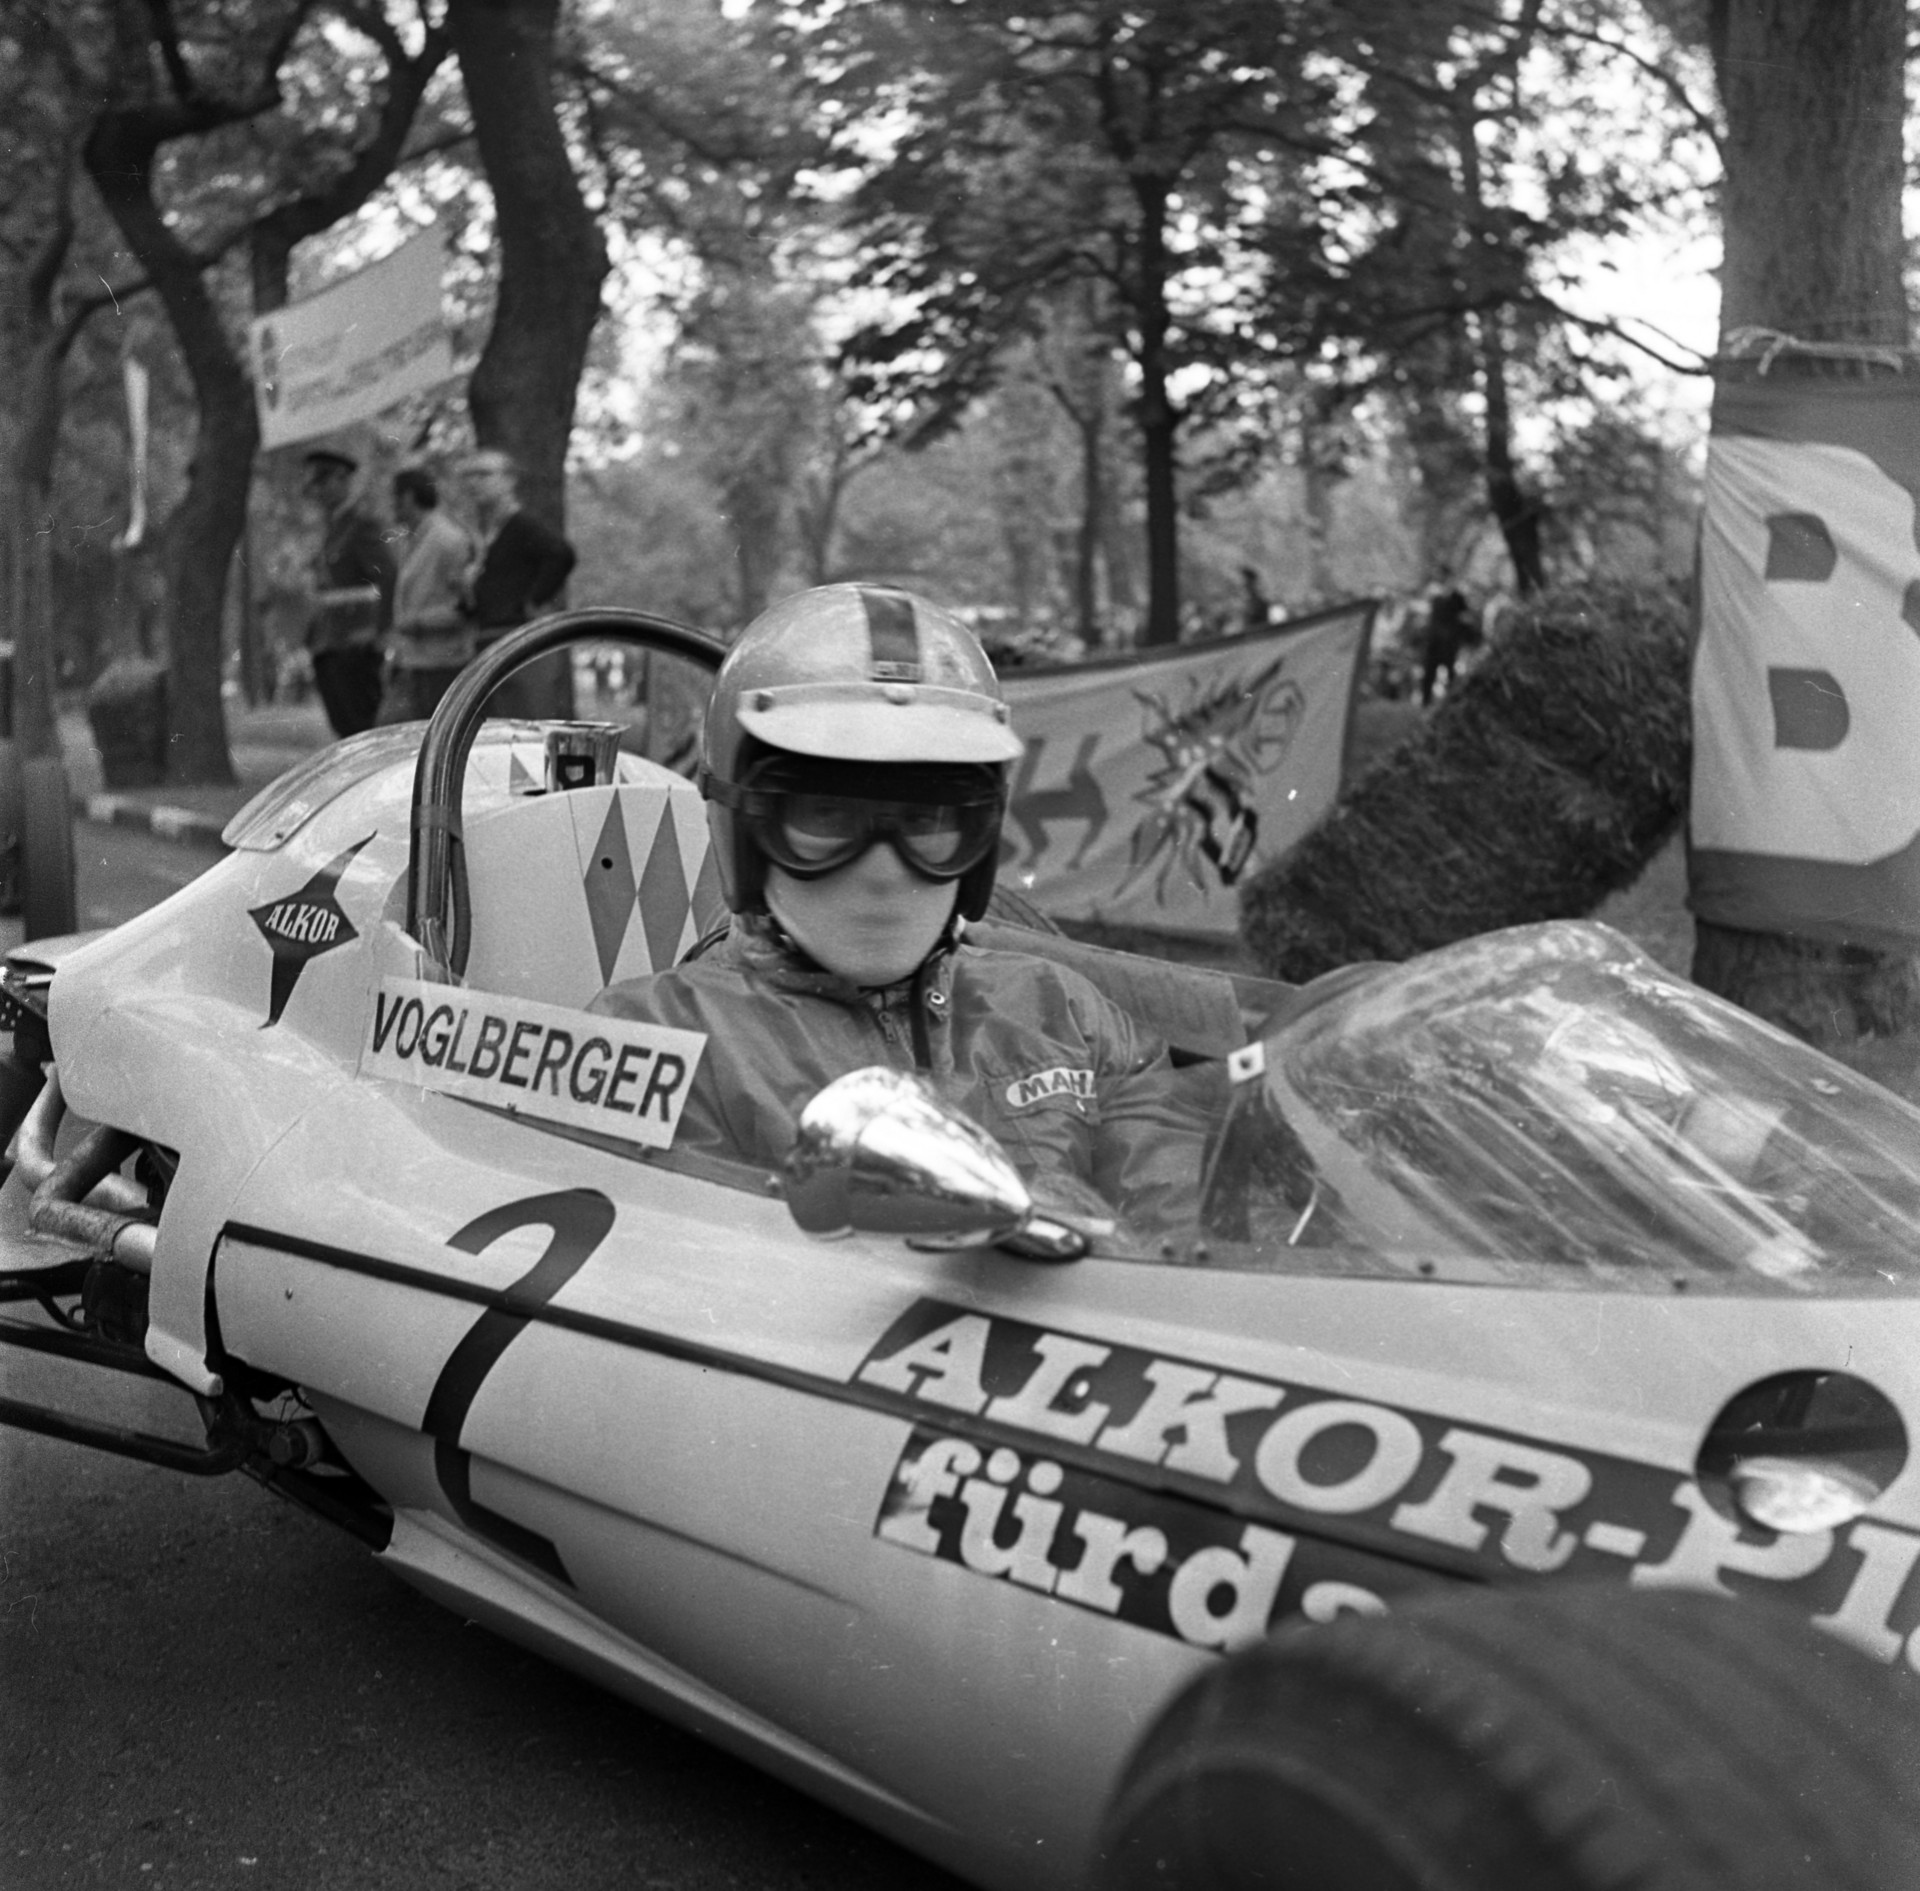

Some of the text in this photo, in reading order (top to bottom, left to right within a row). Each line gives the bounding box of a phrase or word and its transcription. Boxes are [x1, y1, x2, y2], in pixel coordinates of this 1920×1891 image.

[264, 903, 340, 944] ALKOR
[371, 991, 687, 1122] VOGLBERGER
[421, 1187, 617, 1590] 2
